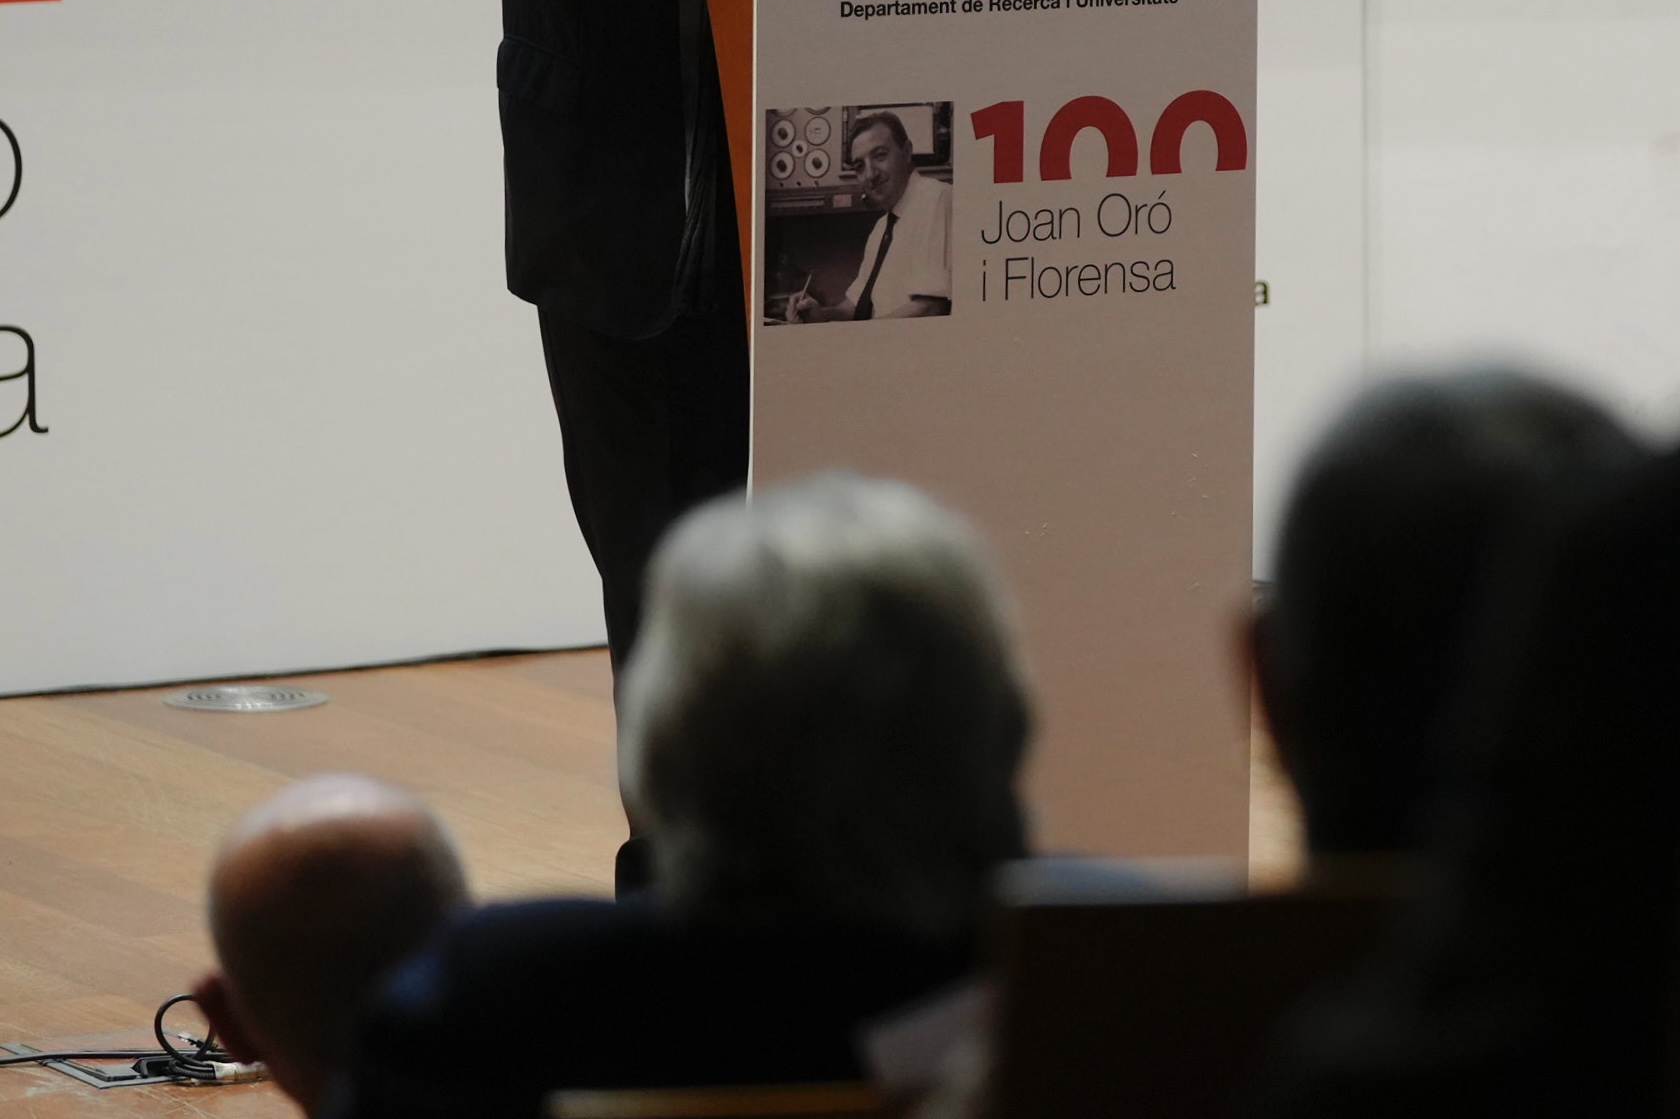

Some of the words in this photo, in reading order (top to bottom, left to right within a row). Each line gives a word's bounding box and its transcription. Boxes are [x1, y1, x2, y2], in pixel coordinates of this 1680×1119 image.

[970, 89, 1248, 184] 100
[981, 200, 1080, 244] Joan
[1097, 190, 1172, 237] Oró
[982, 259, 986, 302] i
[1005, 256, 1176, 301] Florensa
